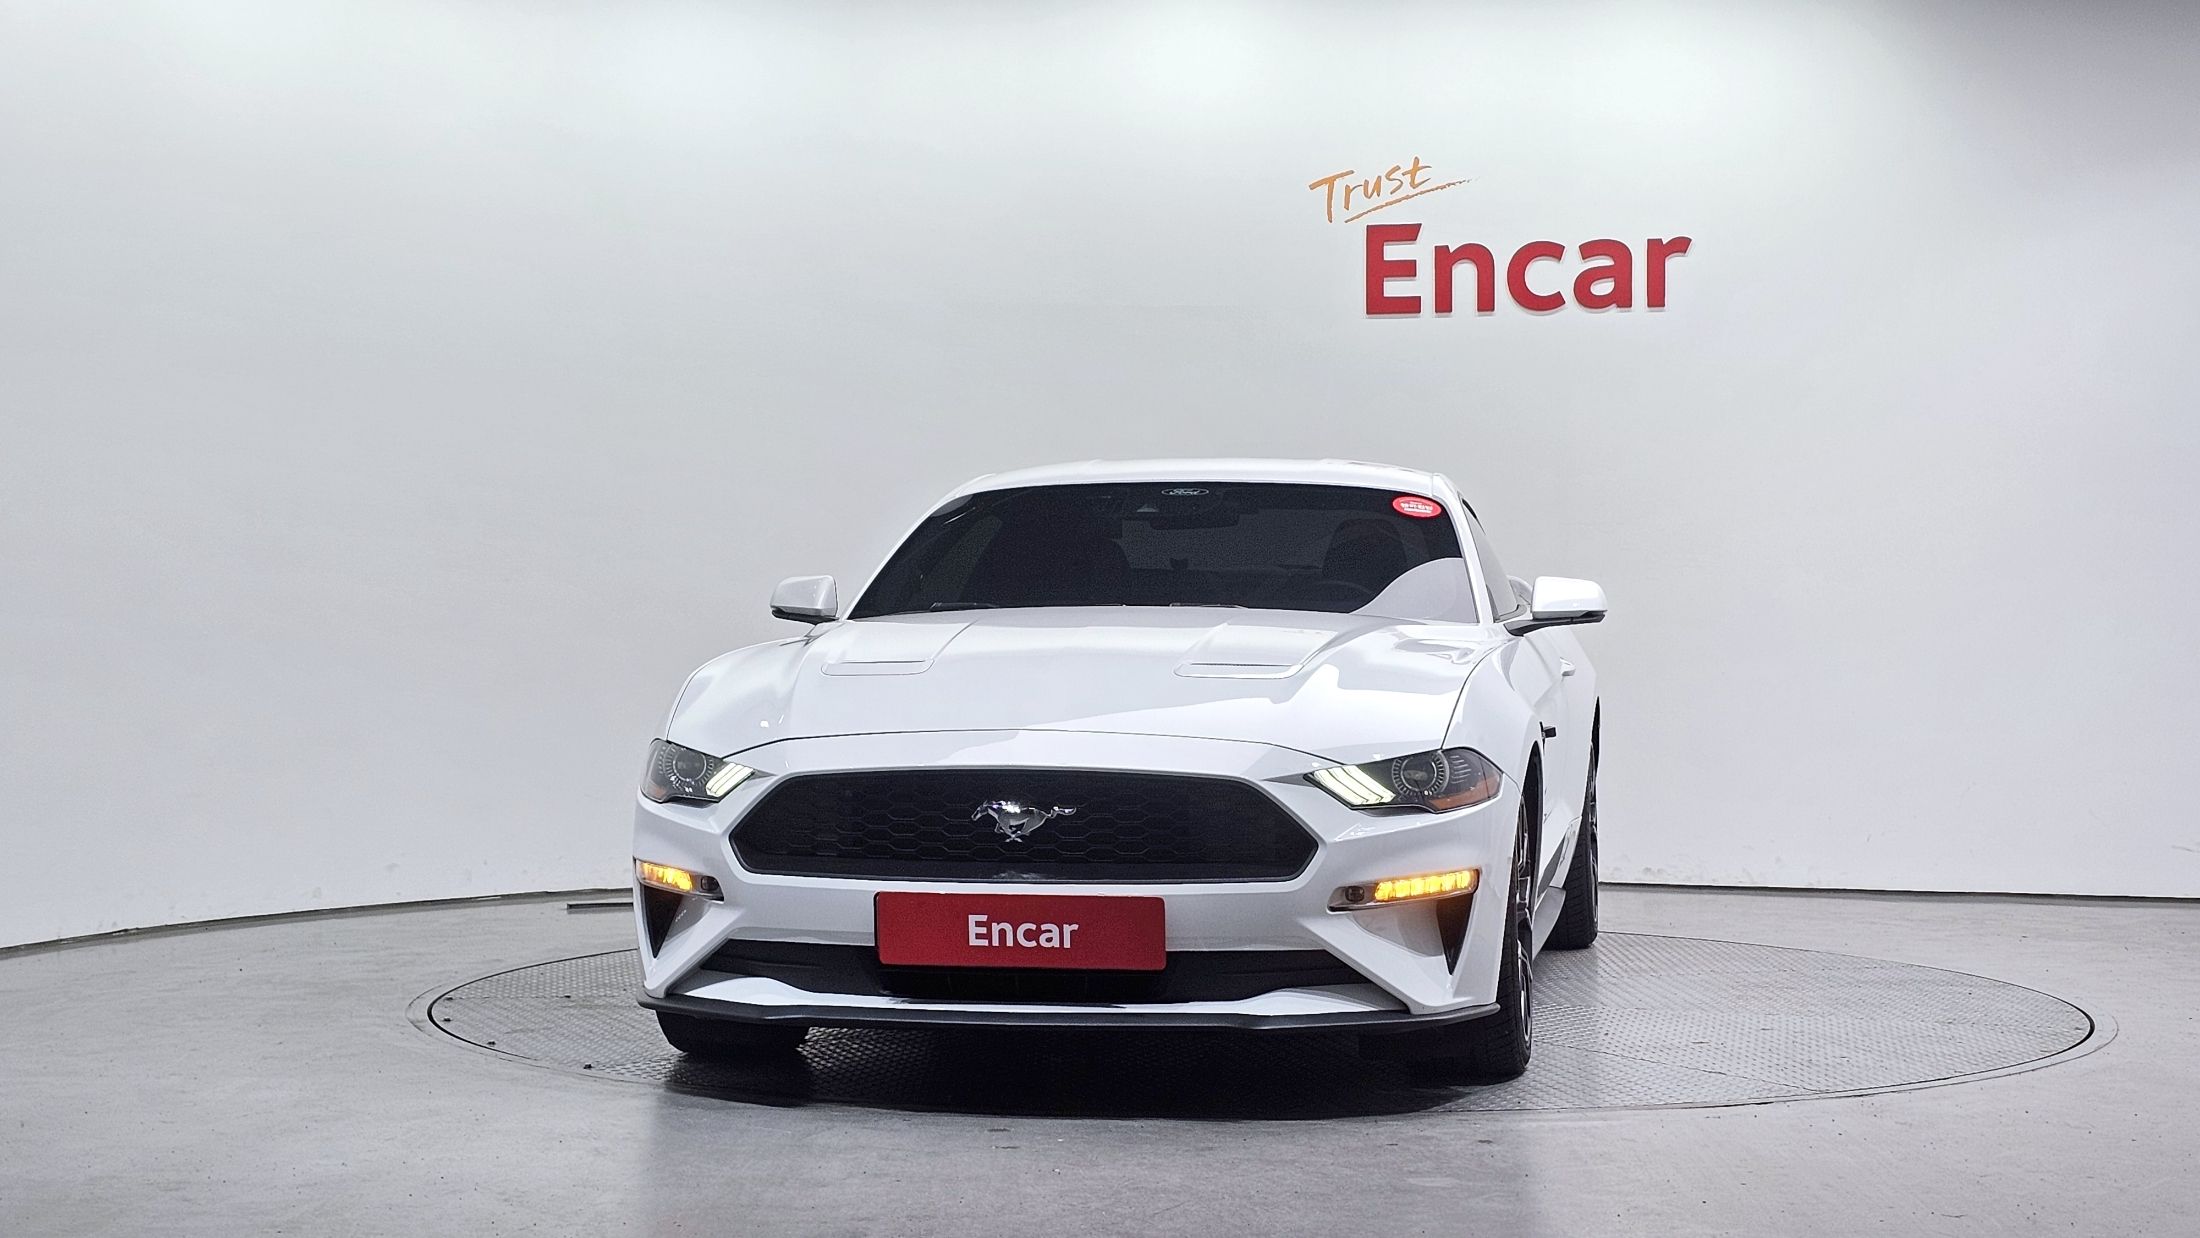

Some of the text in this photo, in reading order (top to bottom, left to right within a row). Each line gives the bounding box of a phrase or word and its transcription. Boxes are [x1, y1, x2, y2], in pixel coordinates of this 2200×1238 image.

[1308, 156, 1433, 224] Trust
[1366, 223, 1693, 316] Encar
[968, 914, 1079, 949] Encar
